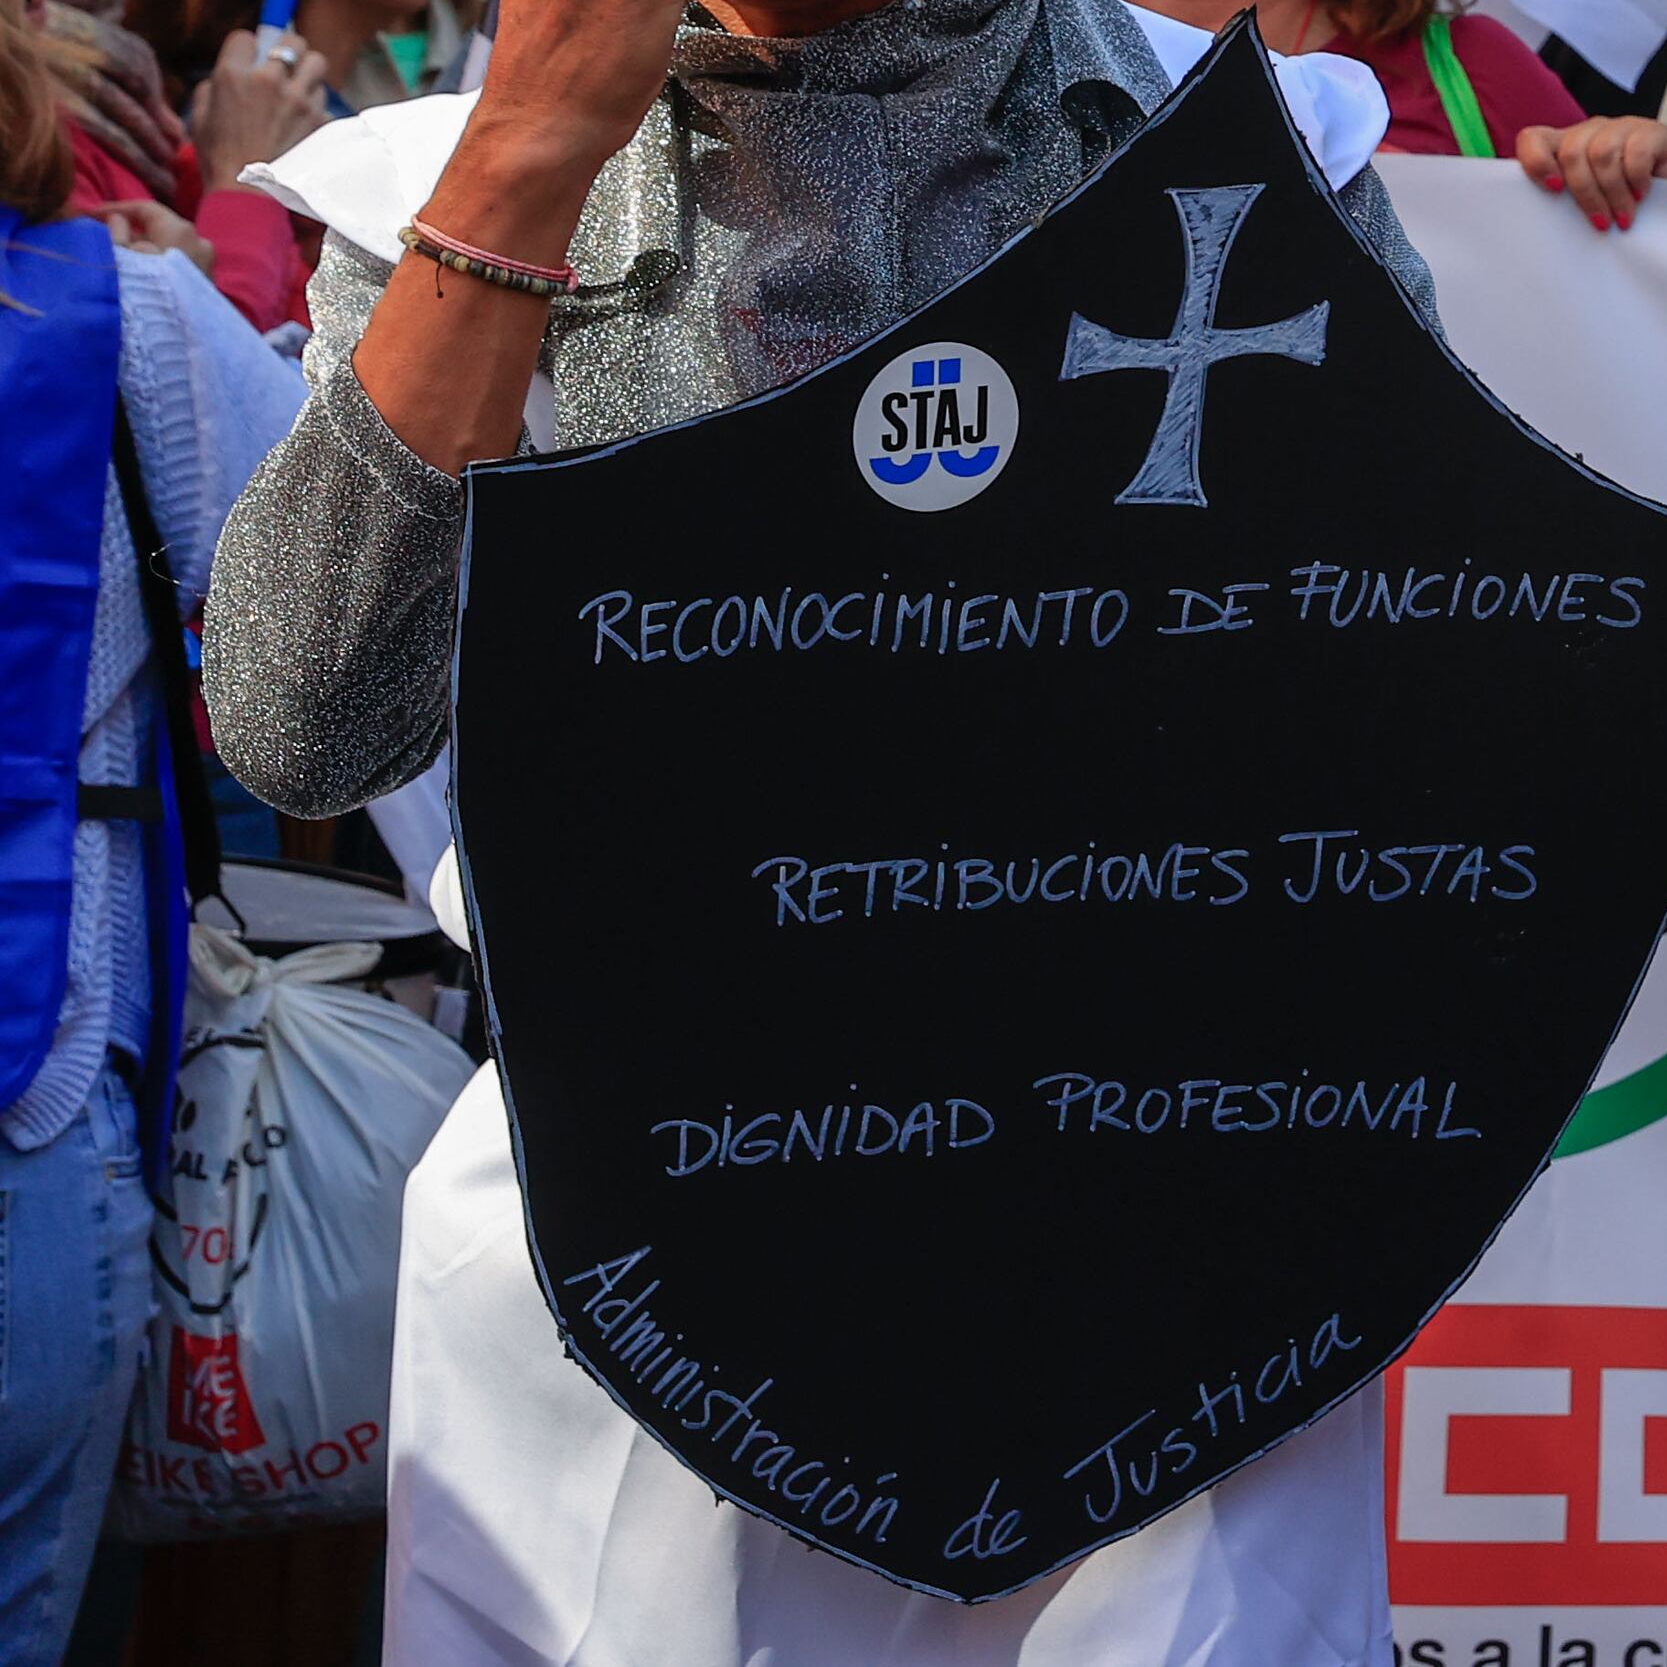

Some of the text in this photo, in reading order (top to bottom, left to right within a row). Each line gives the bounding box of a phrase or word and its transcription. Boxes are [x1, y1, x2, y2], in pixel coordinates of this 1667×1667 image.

[880, 385, 990, 453] STAJ
[578, 556, 1648, 665] RECONOCIMIENTO DE FUNCIONES
[752, 829, 1538, 927] RETRIBUCIONES JUSTAS
[649, 1068, 1482, 1178] DIGNIDAD PROFESIONAL
[562, 1244, 1363, 1558] Administración de Justicia
[232, 1419, 381, 1497] SHOP
[1394, 1636, 1446, 1667] s
